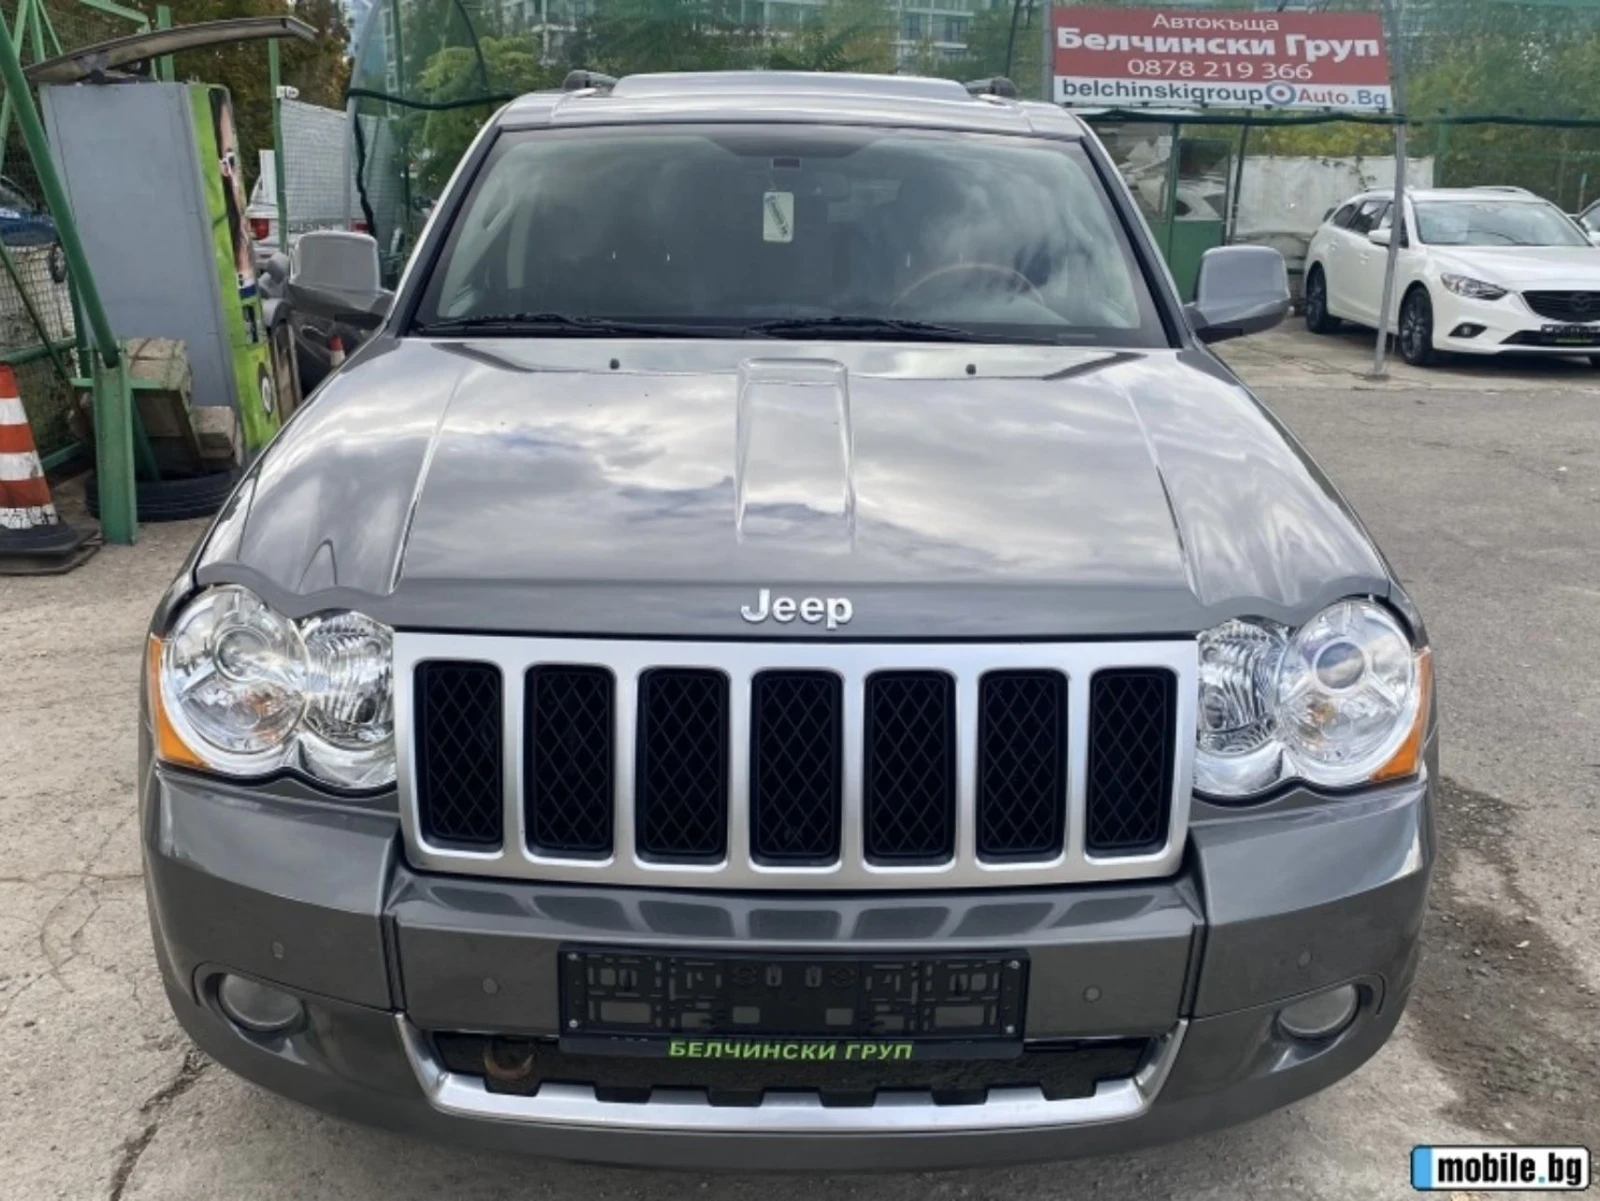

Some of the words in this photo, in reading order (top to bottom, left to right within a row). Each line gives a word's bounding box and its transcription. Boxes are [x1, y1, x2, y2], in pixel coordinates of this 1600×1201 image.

[1152, 13, 1280, 32] Автокъща
[1056, 26, 1276, 55] Белчински
[1285, 33, 1380, 63] Груп
[1127, 59, 1196, 77] 0878
[1203, 61, 1254, 79] 219
[1261, 63, 1314, 80] 366
[741, 588, 853, 631] Jeep
[668, 1040, 837, 1060] БЕЛЧИНСКИ
[844, 1043, 914, 1061] ГРУП
